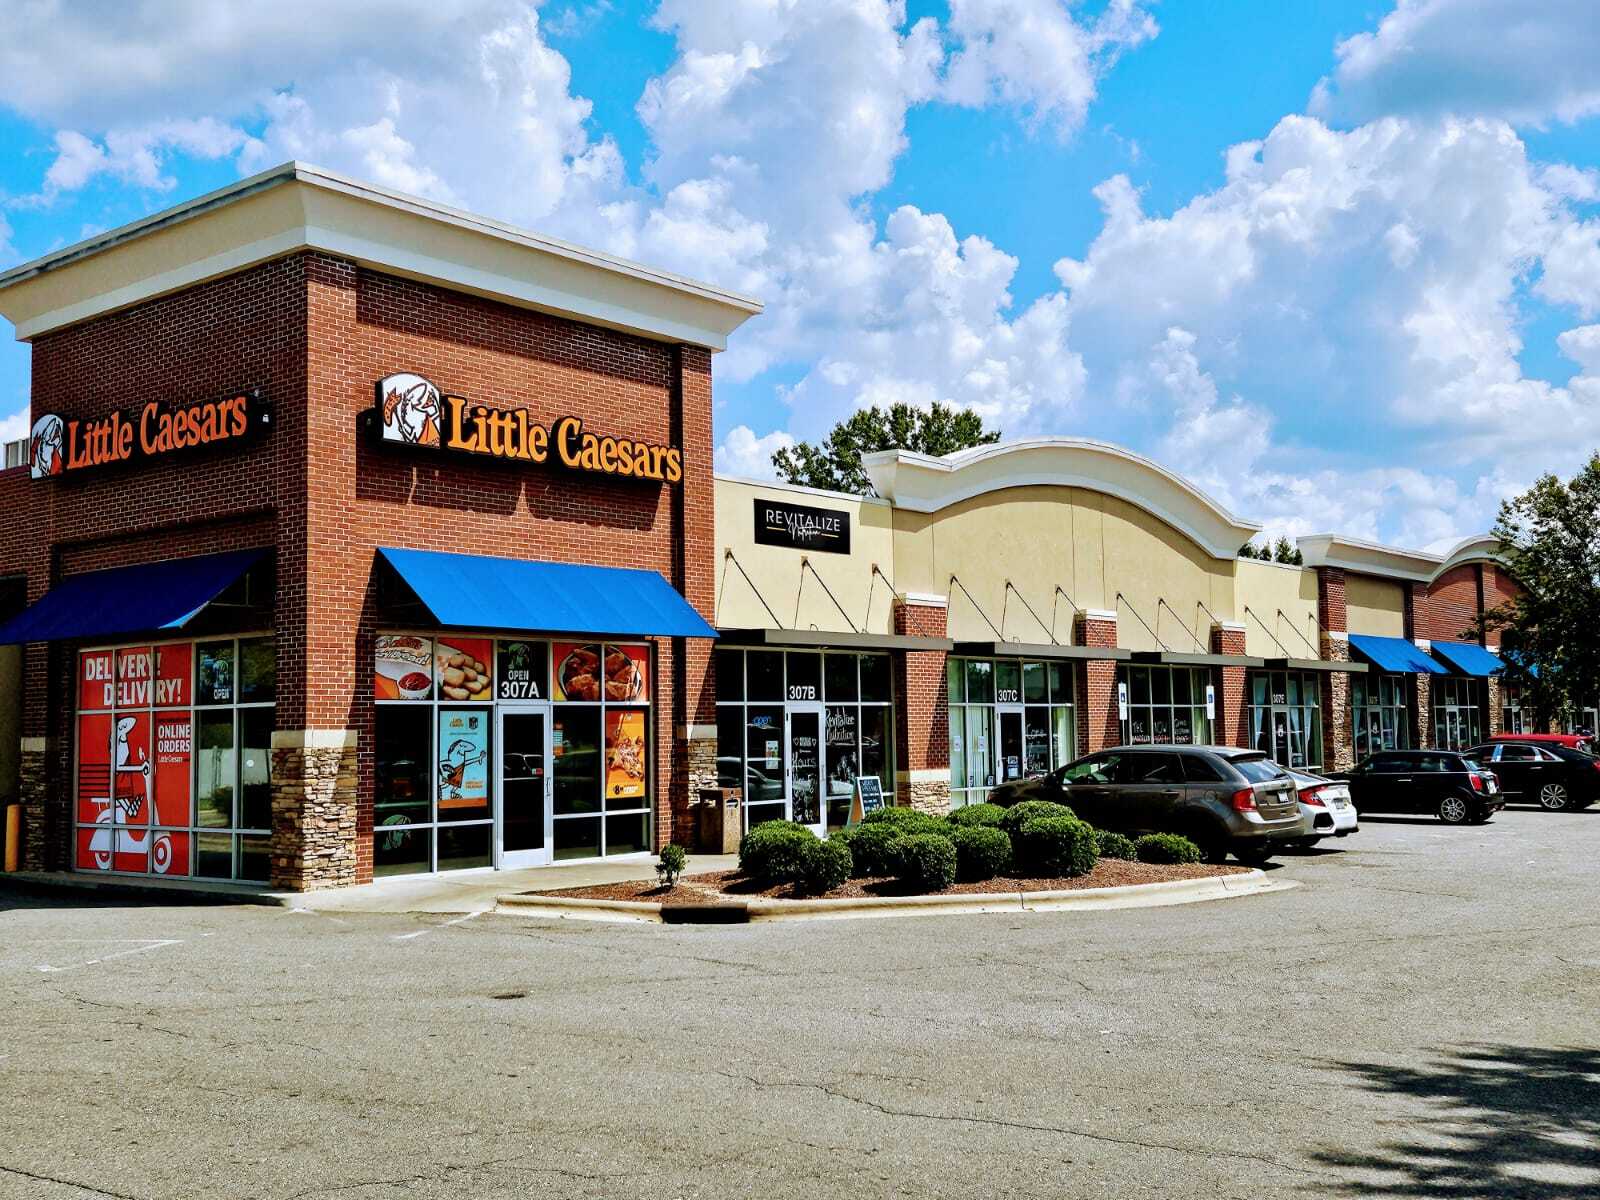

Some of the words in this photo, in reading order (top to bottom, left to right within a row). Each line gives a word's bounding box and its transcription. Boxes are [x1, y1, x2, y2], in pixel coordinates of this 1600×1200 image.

[66, 411, 133, 469] Little
[140, 397, 247, 455] Caesars
[447, 397, 547, 462] Little
[557, 416, 682, 482] Caesars
[766, 509, 841, 531] REVITALIZE
[86, 653, 162, 680] DELVERY!
[508, 670, 530, 681] OPEN
[213, 688, 230, 700] OPEN
[501, 681, 540, 698] 307A
[789, 686, 816, 700] 307B
[998, 690, 1018, 702] 307C
[158, 725, 191, 739] ONLINE
[158, 740, 191, 753] ORDERS
